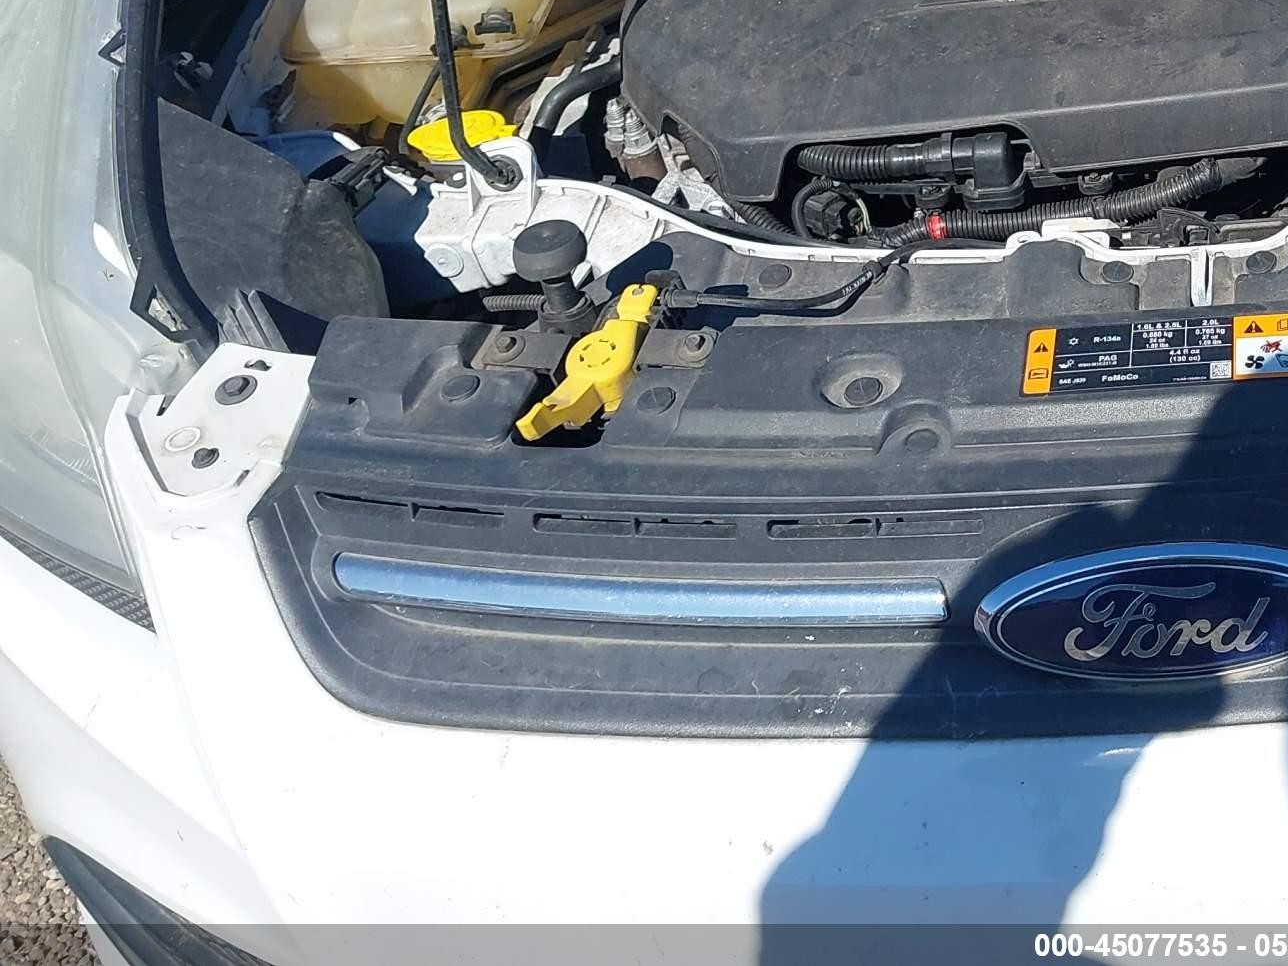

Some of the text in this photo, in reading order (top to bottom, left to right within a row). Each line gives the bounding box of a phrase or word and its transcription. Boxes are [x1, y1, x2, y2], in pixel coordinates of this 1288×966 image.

[1163, 330, 1173, 338] kg
[1216, 327, 1226, 335] kg
[1093, 335, 1121, 343] R-134a
[1101, 373, 1139, 382] FoMoCo
[1065, 582, 1270, 661] Ford
